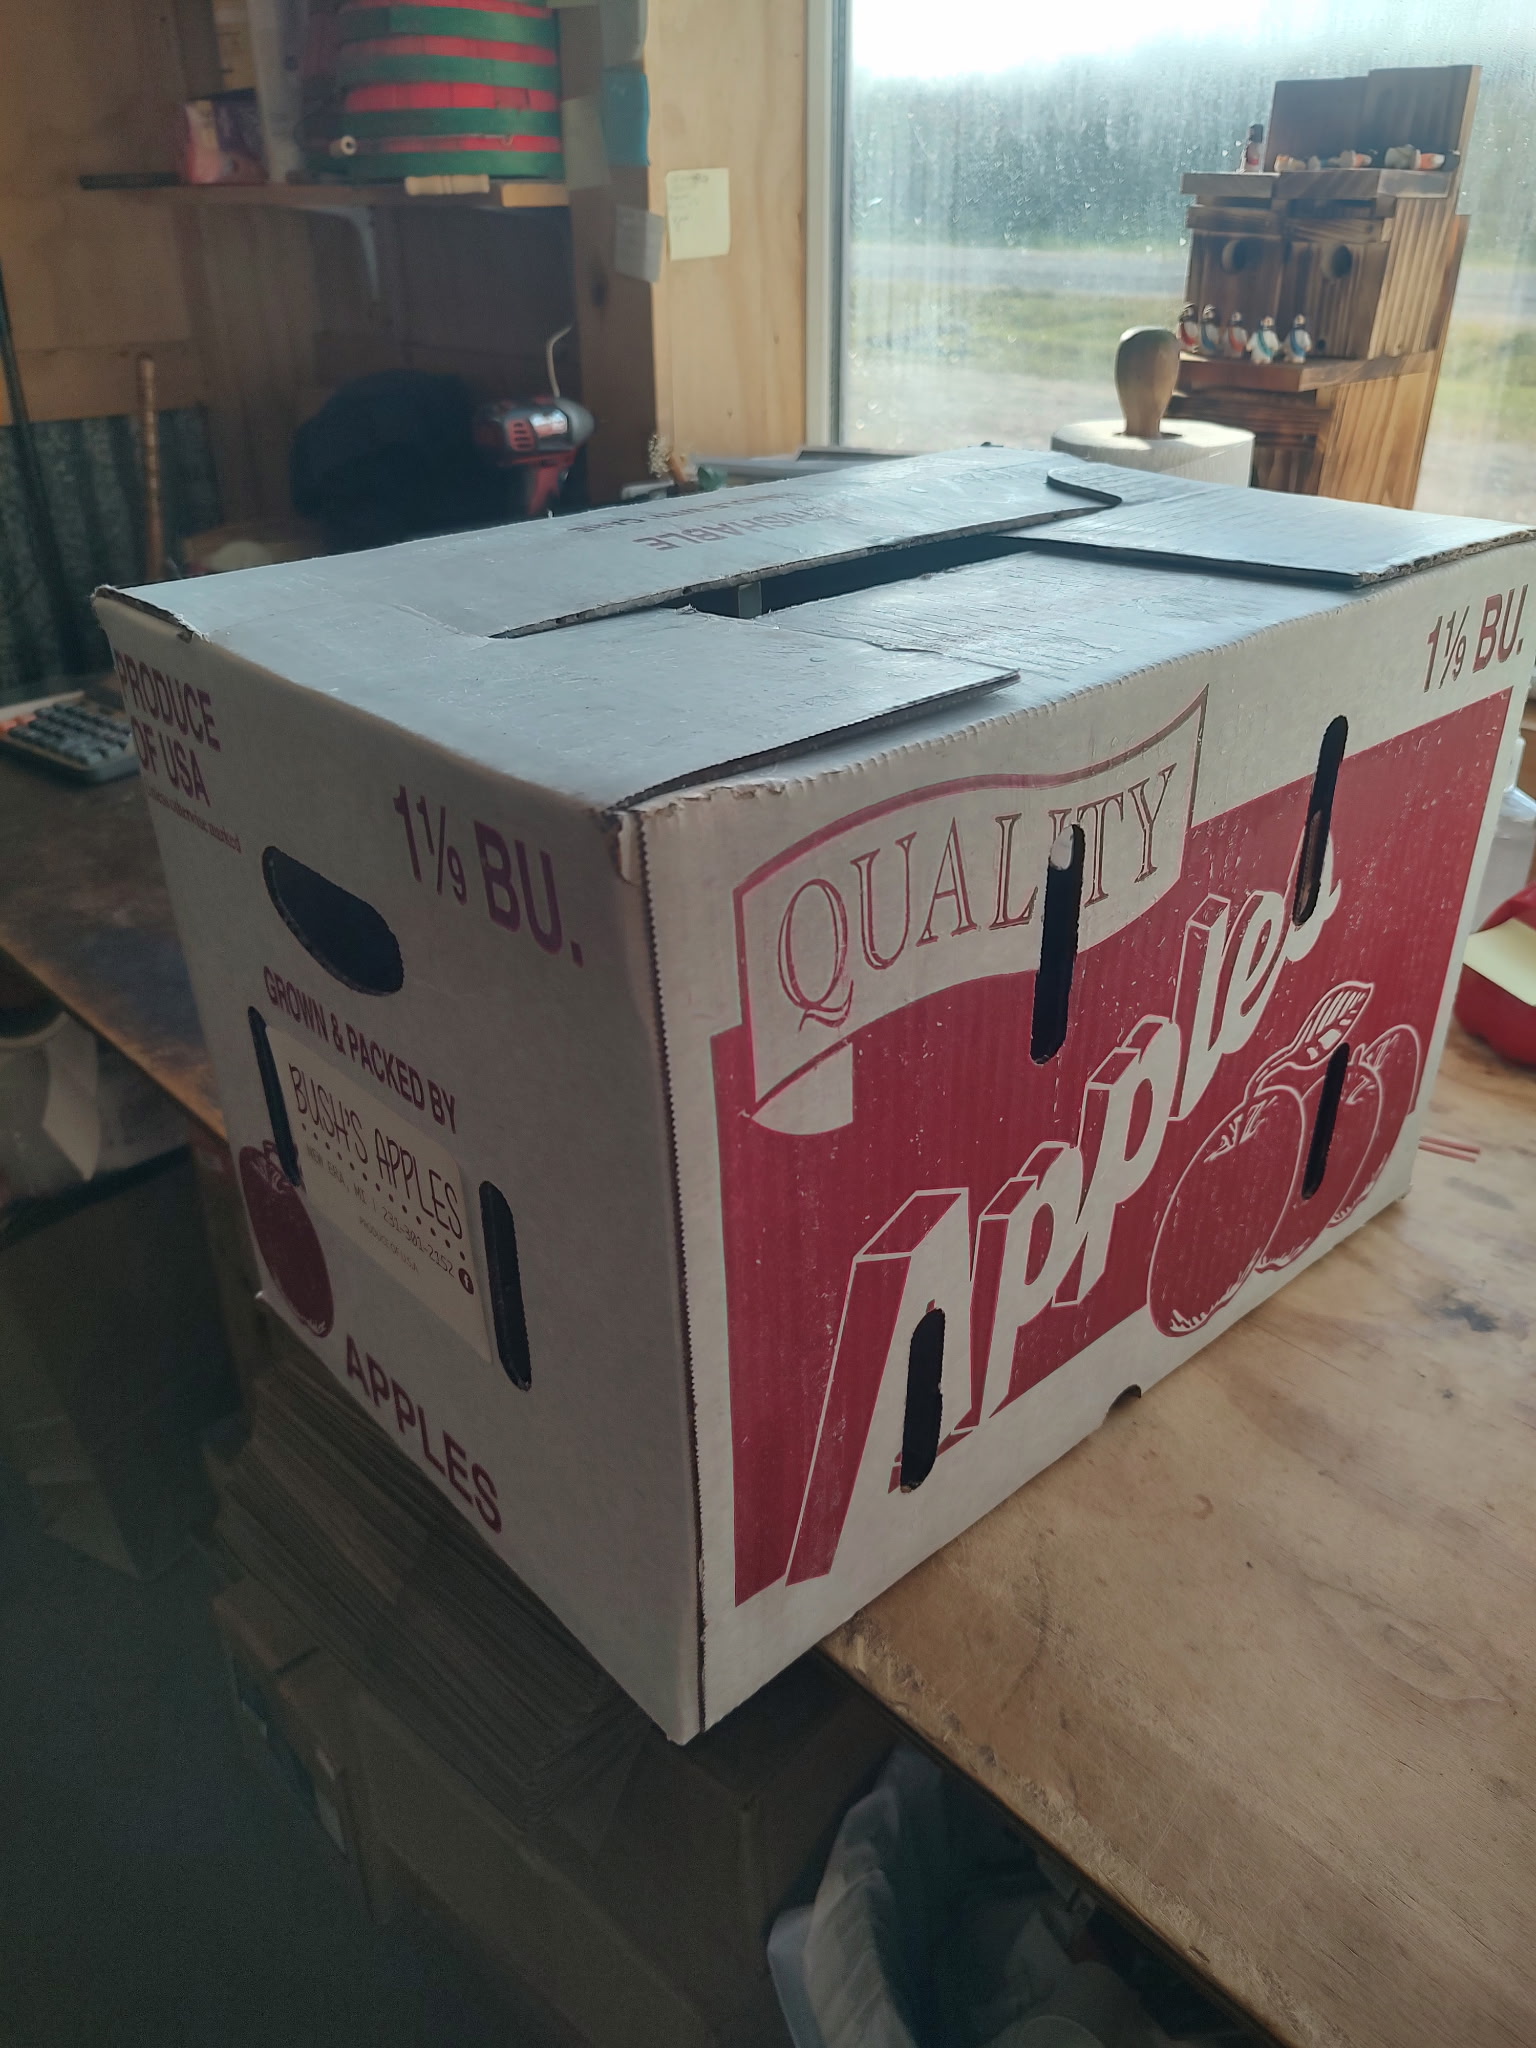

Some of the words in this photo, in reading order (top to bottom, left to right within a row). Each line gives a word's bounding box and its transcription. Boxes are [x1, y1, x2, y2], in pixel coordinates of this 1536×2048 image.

[632, 500, 858, 551] ERISHABLE
[1472, 583, 1529, 674] BU.
[114, 650, 221, 752] PRODUCE
[131, 715, 157, 775] OF
[159, 731, 211, 808] USA
[474, 819, 584, 968] BU.
[263, 965, 330, 1043] GROWN
[331, 1012, 347, 1056] &
[345, 1023, 426, 1111] PACKED
[427, 1079, 457, 1135] BY
[288, 1062, 368, 1164] BUSH'S
[374, 1127, 463, 1240] APPLES
[382, 1206, 455, 1278] 231-301-2152
[346, 1333, 502, 1534] APPLES
